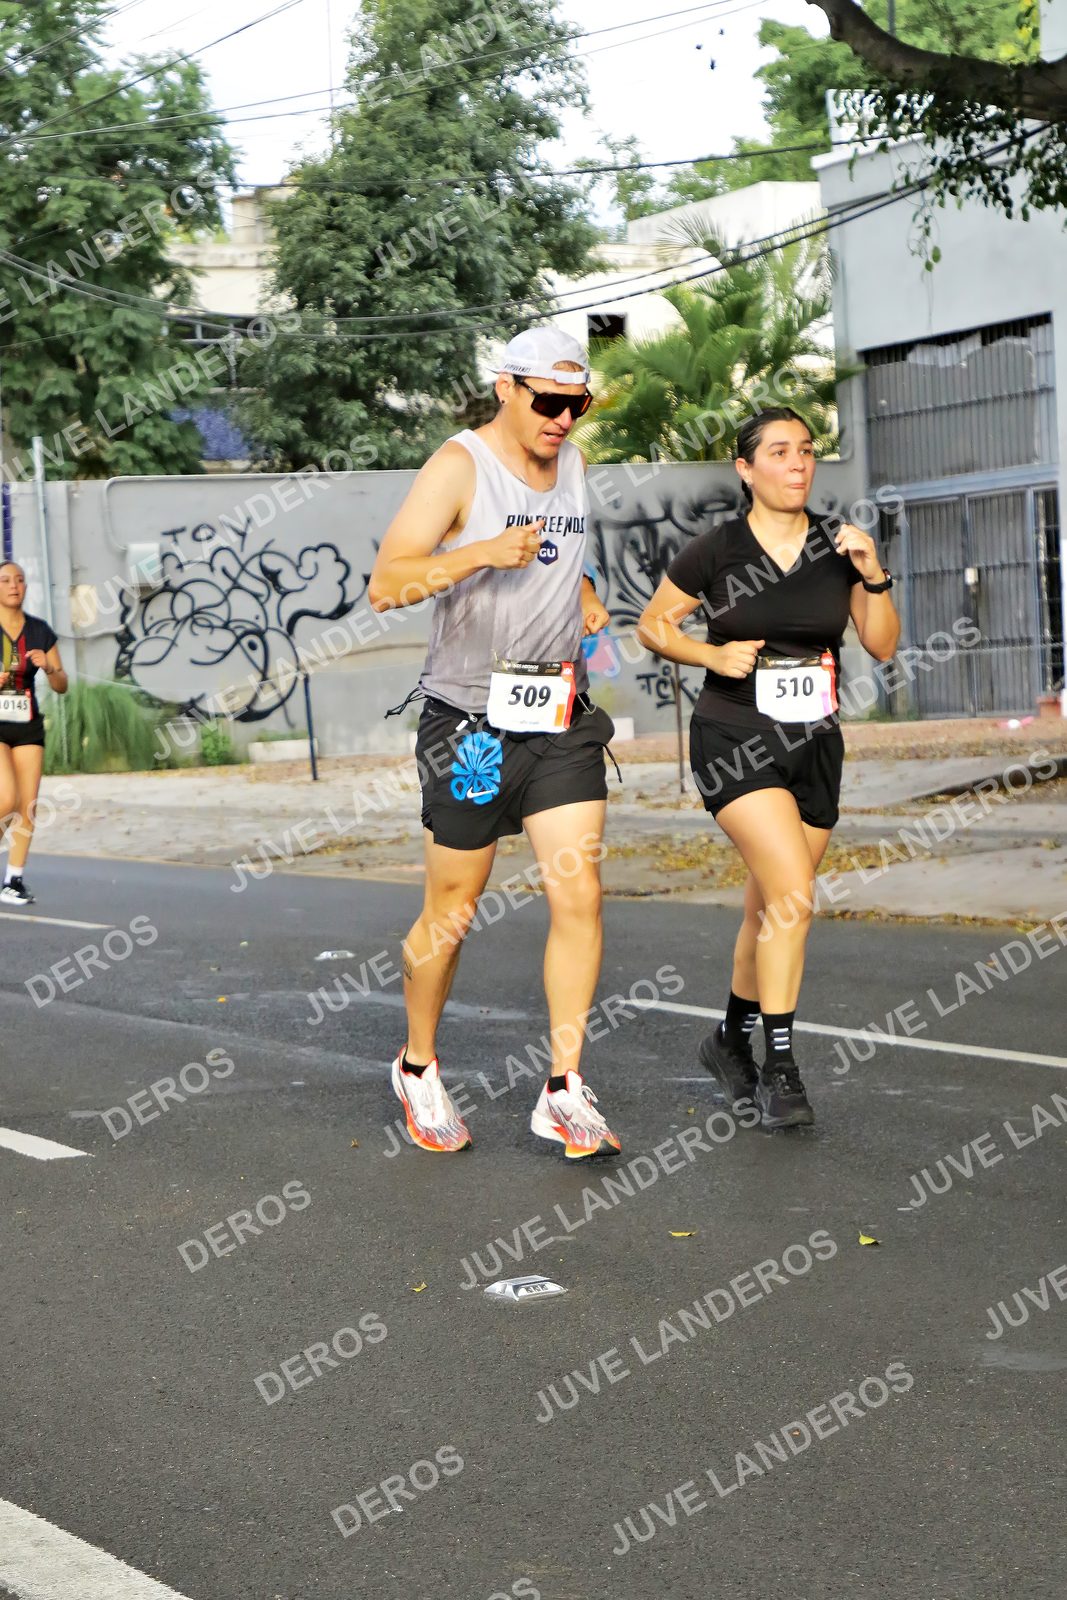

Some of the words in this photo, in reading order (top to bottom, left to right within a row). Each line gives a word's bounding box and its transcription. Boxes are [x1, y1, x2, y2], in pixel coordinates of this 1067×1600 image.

[539, 548, 556, 558] GU
[776, 676, 814, 698] 510
[508, 684, 551, 708] 509
[0, 699, 28, 710] 0145
